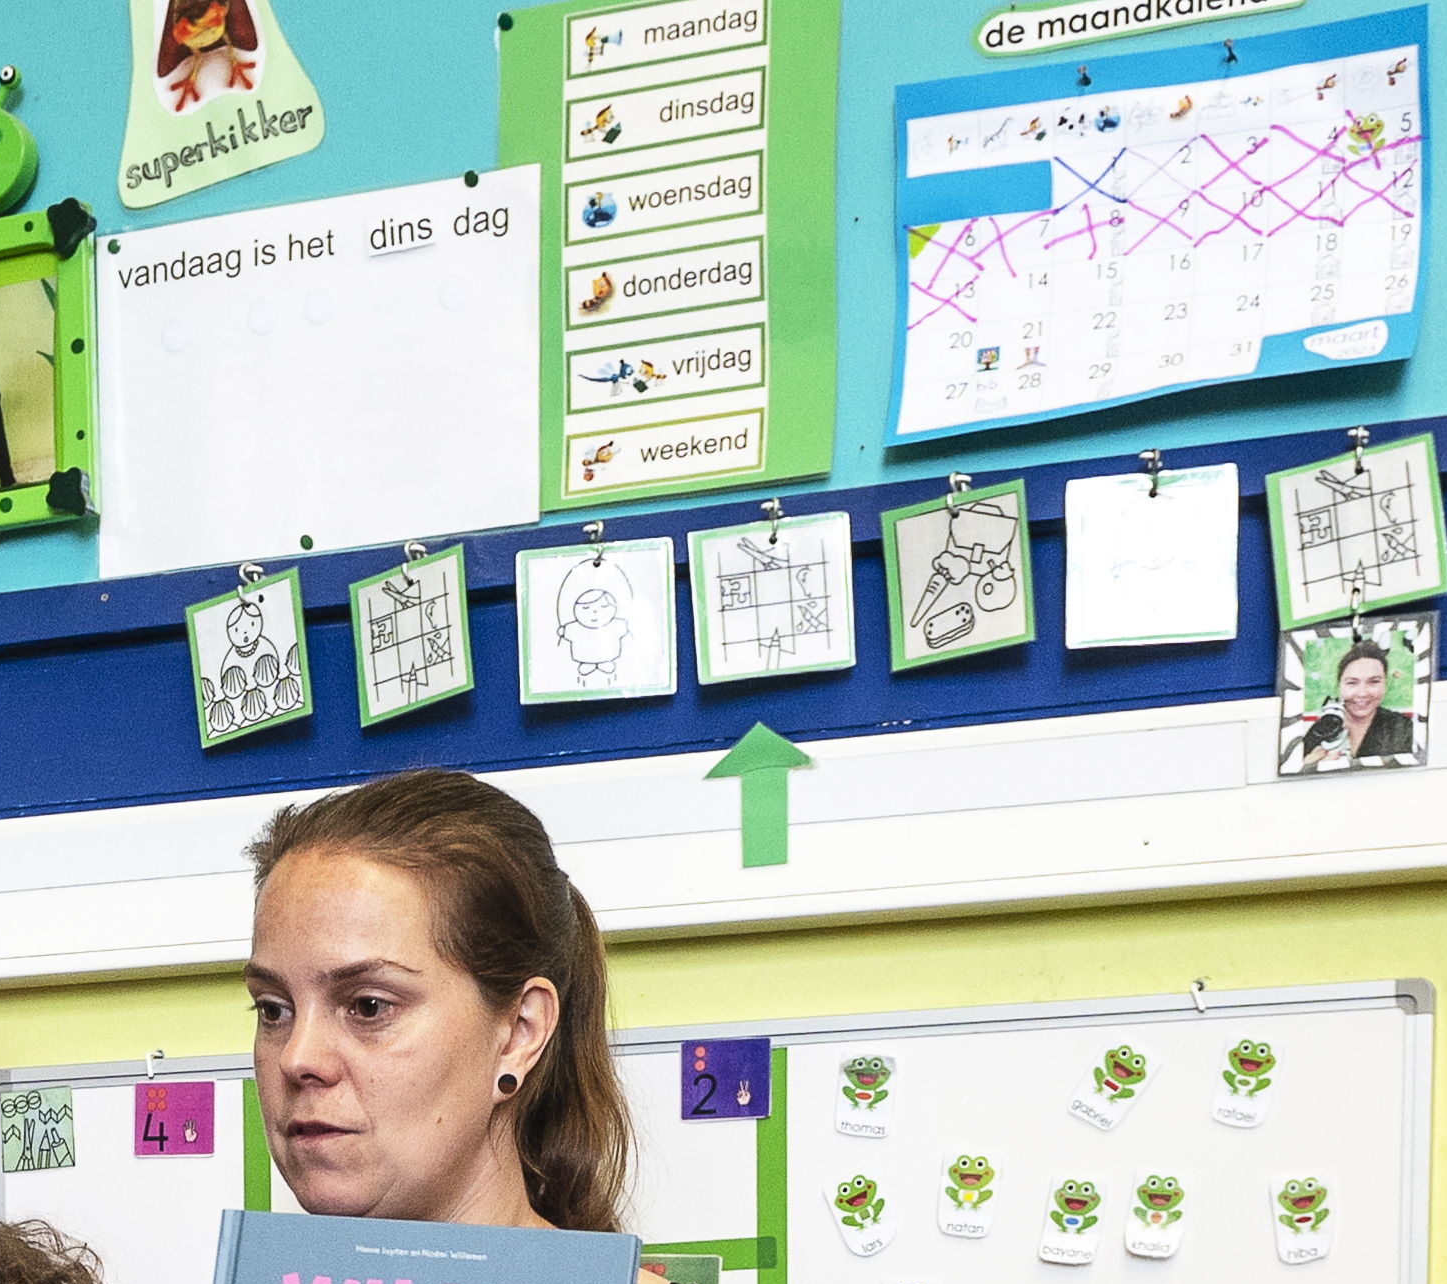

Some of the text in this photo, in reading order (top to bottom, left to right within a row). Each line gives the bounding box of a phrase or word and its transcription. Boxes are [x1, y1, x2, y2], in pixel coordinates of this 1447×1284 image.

[644, 9, 758, 51] maandag
[985, 21, 1025, 48] de
[659, 88, 756, 125] dinsdag
[125, 101, 314, 190] superkikker
[1178, 145, 1192, 164] 2
[1246, 136, 1258, 155] 3
[1400, 112, 1413, 132] 5
[628, 174, 754, 213] woensdag
[965, 228, 977, 247] 6
[1039, 218, 1050, 237] 7
[1109, 209, 1121, 229] 8
[1178, 199, 1191, 218] 9
[1242, 189, 1263, 208] 10
[1393, 169, 1415, 188] 12
[118, 203, 510, 290] vandaag is het dins dag
[955, 223, 1412, 299] 13 14 15 16 17 18 19
[622, 257, 754, 299] donderdag
[949, 274, 1409, 350] 20 21 22 23 24 25 26
[1310, 325, 1381, 347] maart
[671, 345, 753, 382] vrijdag
[945, 381, 970, 401] 27
[1018, 371, 1042, 390] 28
[1087, 361, 1113, 380] 29
[1157, 351, 1185, 368] 30
[1228, 340, 1254, 357] 31
[639, 429, 749, 465] weekend
[691, 1072, 718, 1117] 2
[1070, 1098, 1114, 1129] gabriel
[1217, 1105, 1258, 1124] rafael
[142, 1111, 170, 1152] 4
[840, 1119, 886, 1136] thomas
[861, 1237, 884, 1254] lars
[946, 1221, 985, 1235] natan
